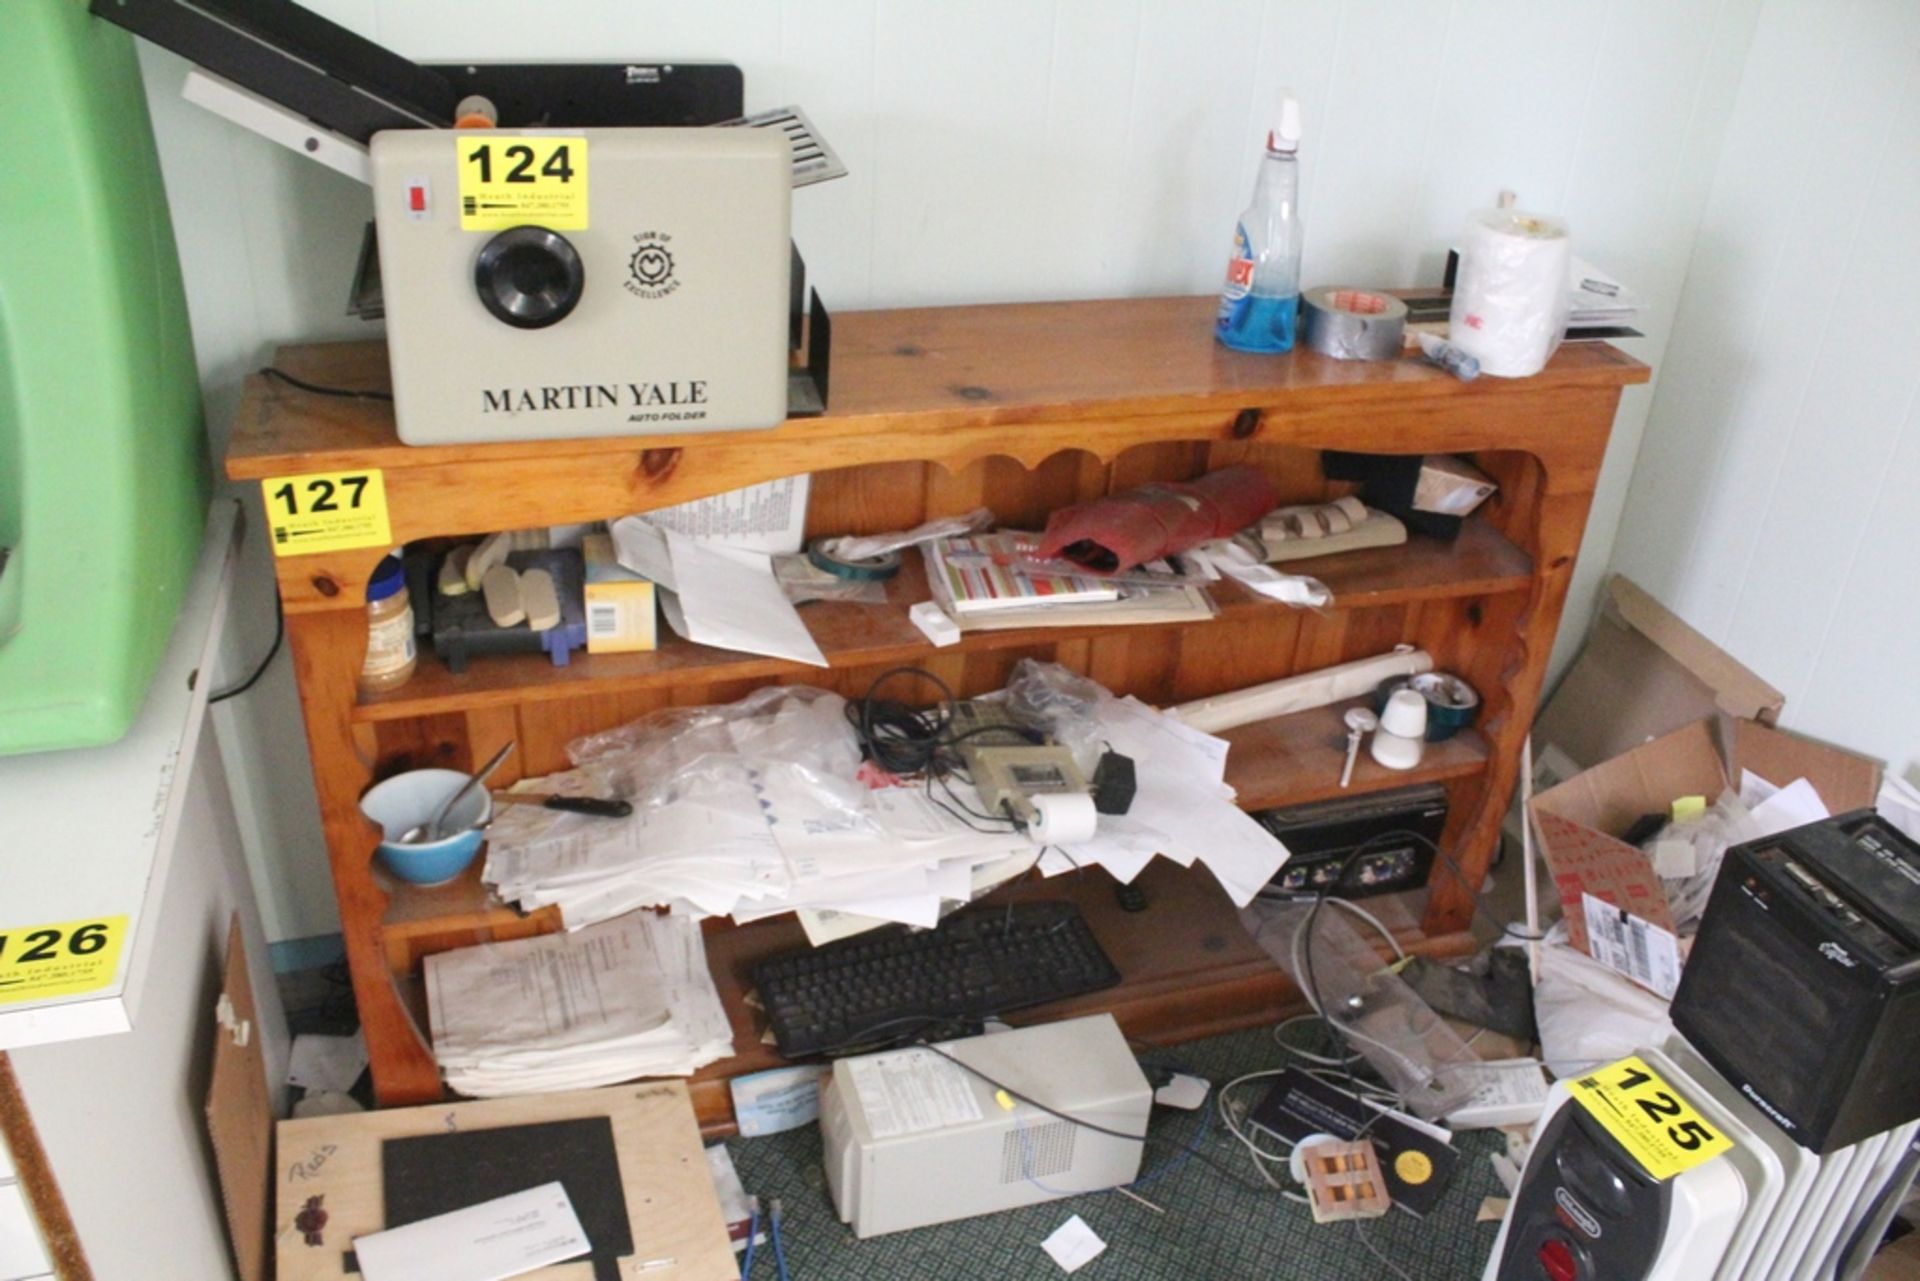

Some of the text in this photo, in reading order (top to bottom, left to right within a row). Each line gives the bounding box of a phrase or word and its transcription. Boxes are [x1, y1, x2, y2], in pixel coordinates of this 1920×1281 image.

[469, 145, 574, 183] 124
[516, 192, 575, 200] Industrial
[633, 231, 672, 243] SIGN OF
[623, 280, 681, 299] EXCELLENCE
[482, 380, 708, 413] MARTIN YALE
[627, 411, 707, 422] AUTO FOLDER
[275, 476, 369, 515] 127
[1617, 1068, 1714, 1150] 125
